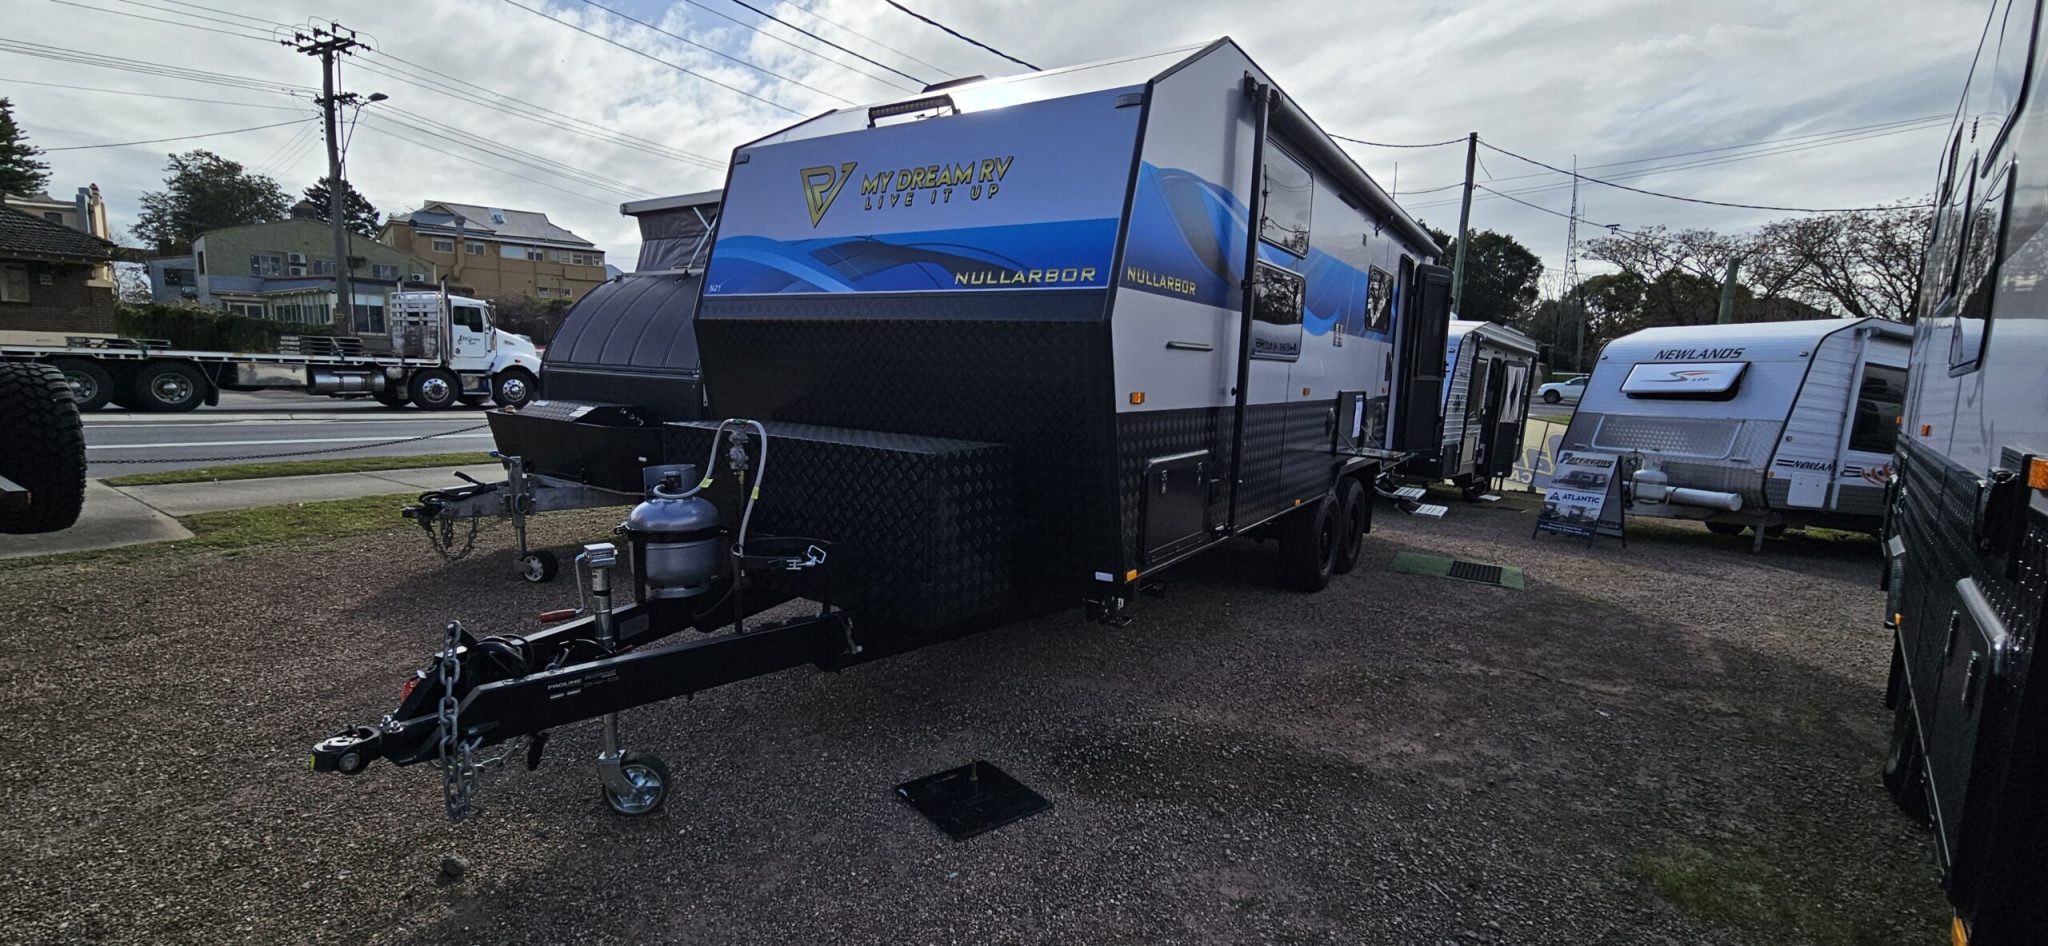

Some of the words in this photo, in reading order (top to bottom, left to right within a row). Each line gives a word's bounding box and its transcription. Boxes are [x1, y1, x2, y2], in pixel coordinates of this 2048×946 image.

[861, 170, 895, 195] MY
[896, 160, 976, 192] DREAM
[978, 155, 1014, 183] RV
[864, 192, 915, 211] LIVE
[930, 187, 953, 205] IT
[969, 183, 1000, 202] UP
[954, 267, 1096, 285] NULLARBOR
[1127, 266, 1197, 296] NULLARBOR
[1654, 347, 1746, 360] NEWLANDS
[1792, 460, 1833, 472] NEWLAN
[1562, 493, 1600, 504] ATLANTIC
[547, 678, 582, 690] PROLINE
